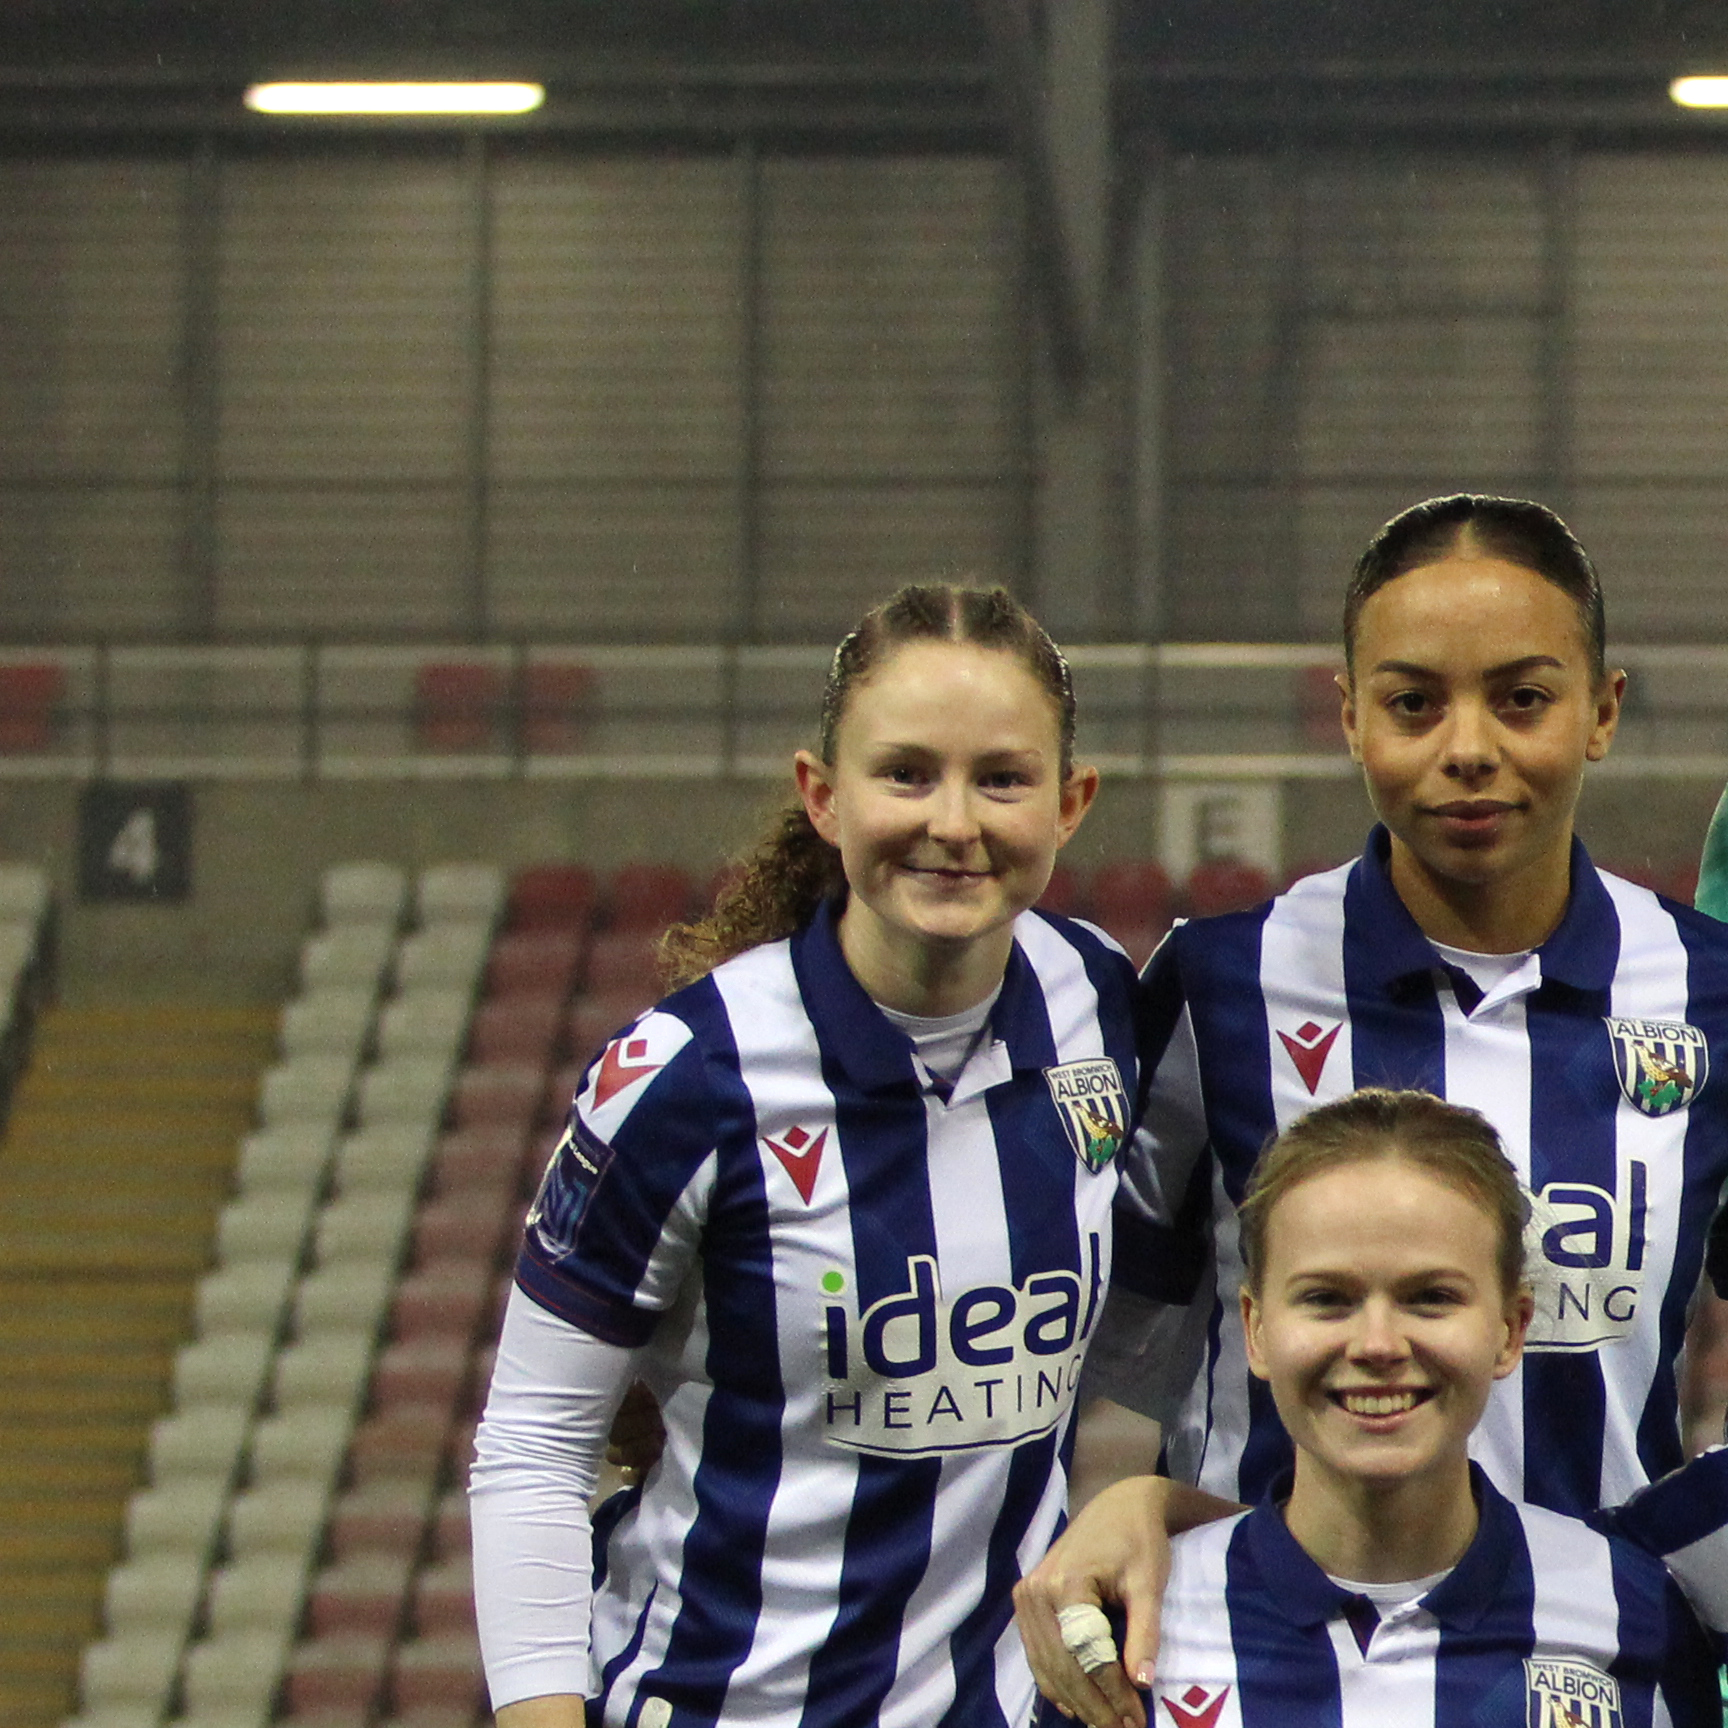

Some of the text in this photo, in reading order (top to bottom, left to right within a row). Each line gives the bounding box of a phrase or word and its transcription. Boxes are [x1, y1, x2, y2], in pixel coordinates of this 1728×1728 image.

[110, 808, 160, 882] 4
[1616, 1022, 1698, 1043] ALBION
[1057, 1073, 1118, 1098] ALBION
[820, 1231, 1101, 1381] ideal
[826, 1358, 1082, 1431] HEATING
[1535, 1672, 1613, 1706] ALBION
